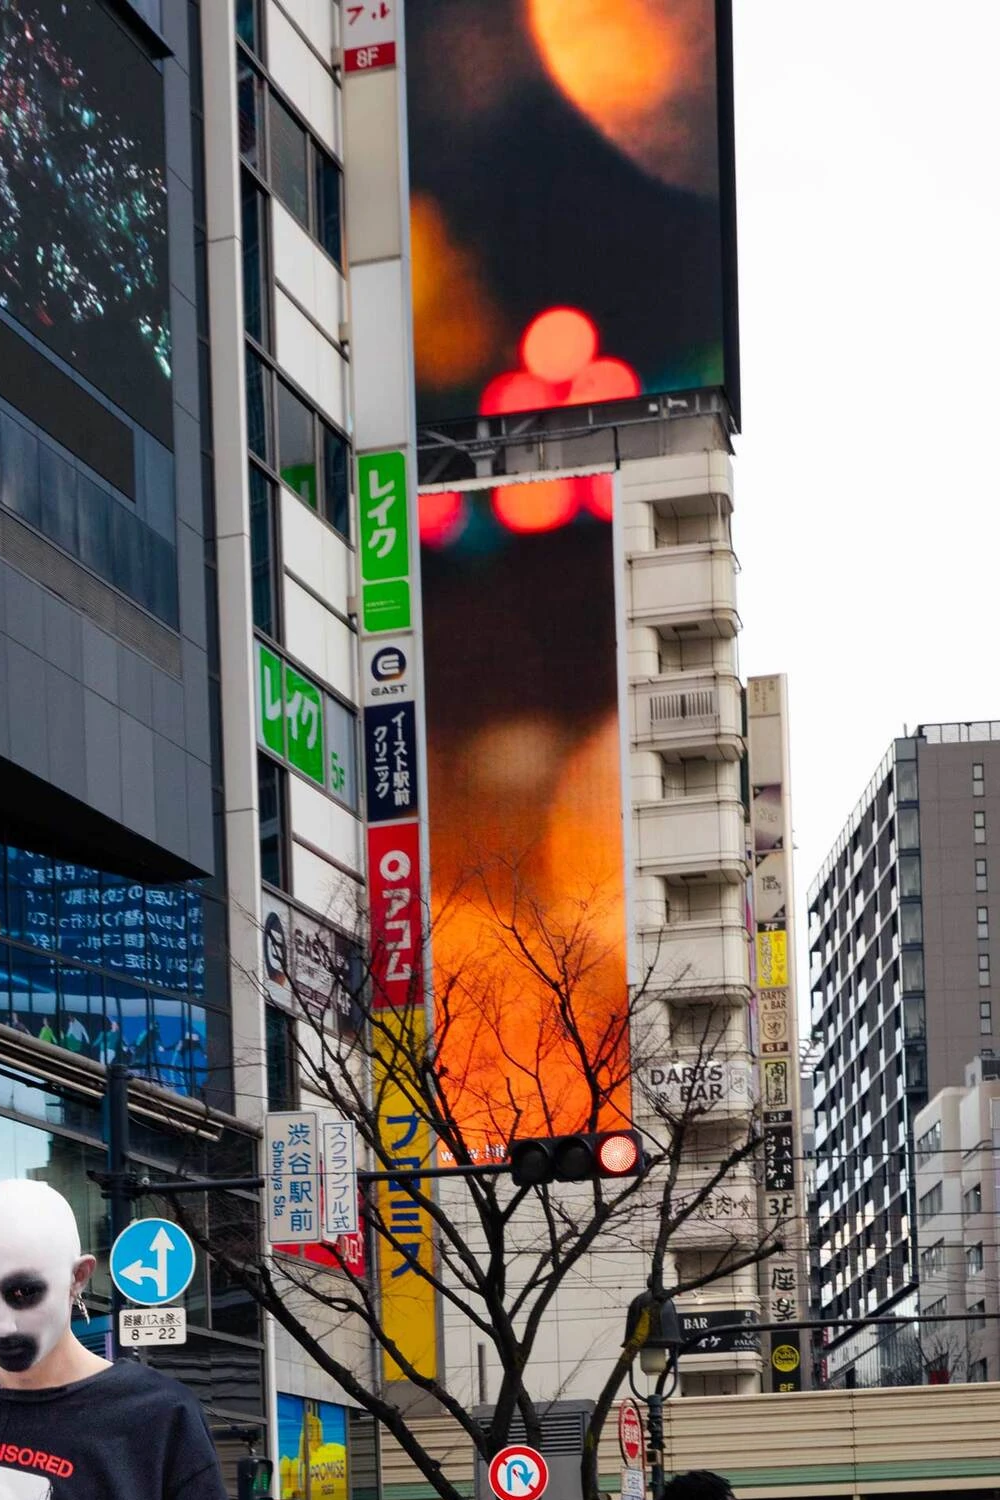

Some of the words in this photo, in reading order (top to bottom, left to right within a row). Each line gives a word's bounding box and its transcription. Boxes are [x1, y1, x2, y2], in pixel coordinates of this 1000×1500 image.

[356, 46, 380, 68] 8F
[368, 469, 398, 559] レイク
[264, 665, 321, 750] レイク
[371, 683, 408, 697] EAST
[373, 726, 390, 799] クリニック
[391, 711, 411, 806] イースト駅前
[382, 887, 412, 982] アコム
[760, 990, 787, 1002] DARTS
[770, 1000, 787, 1010] BAR
[651, 1064, 724, 1086] DARTS
[680, 1083, 724, 1102] BAR
[271, 1140, 286, 1192] Shibuya
[287, 1122, 313, 1233] 渋谷駅前
[330, 1126, 351, 1230] スクランブル式
[768, 1197, 793, 1216] 3F
[683, 1317, 709, 1330] BAR
